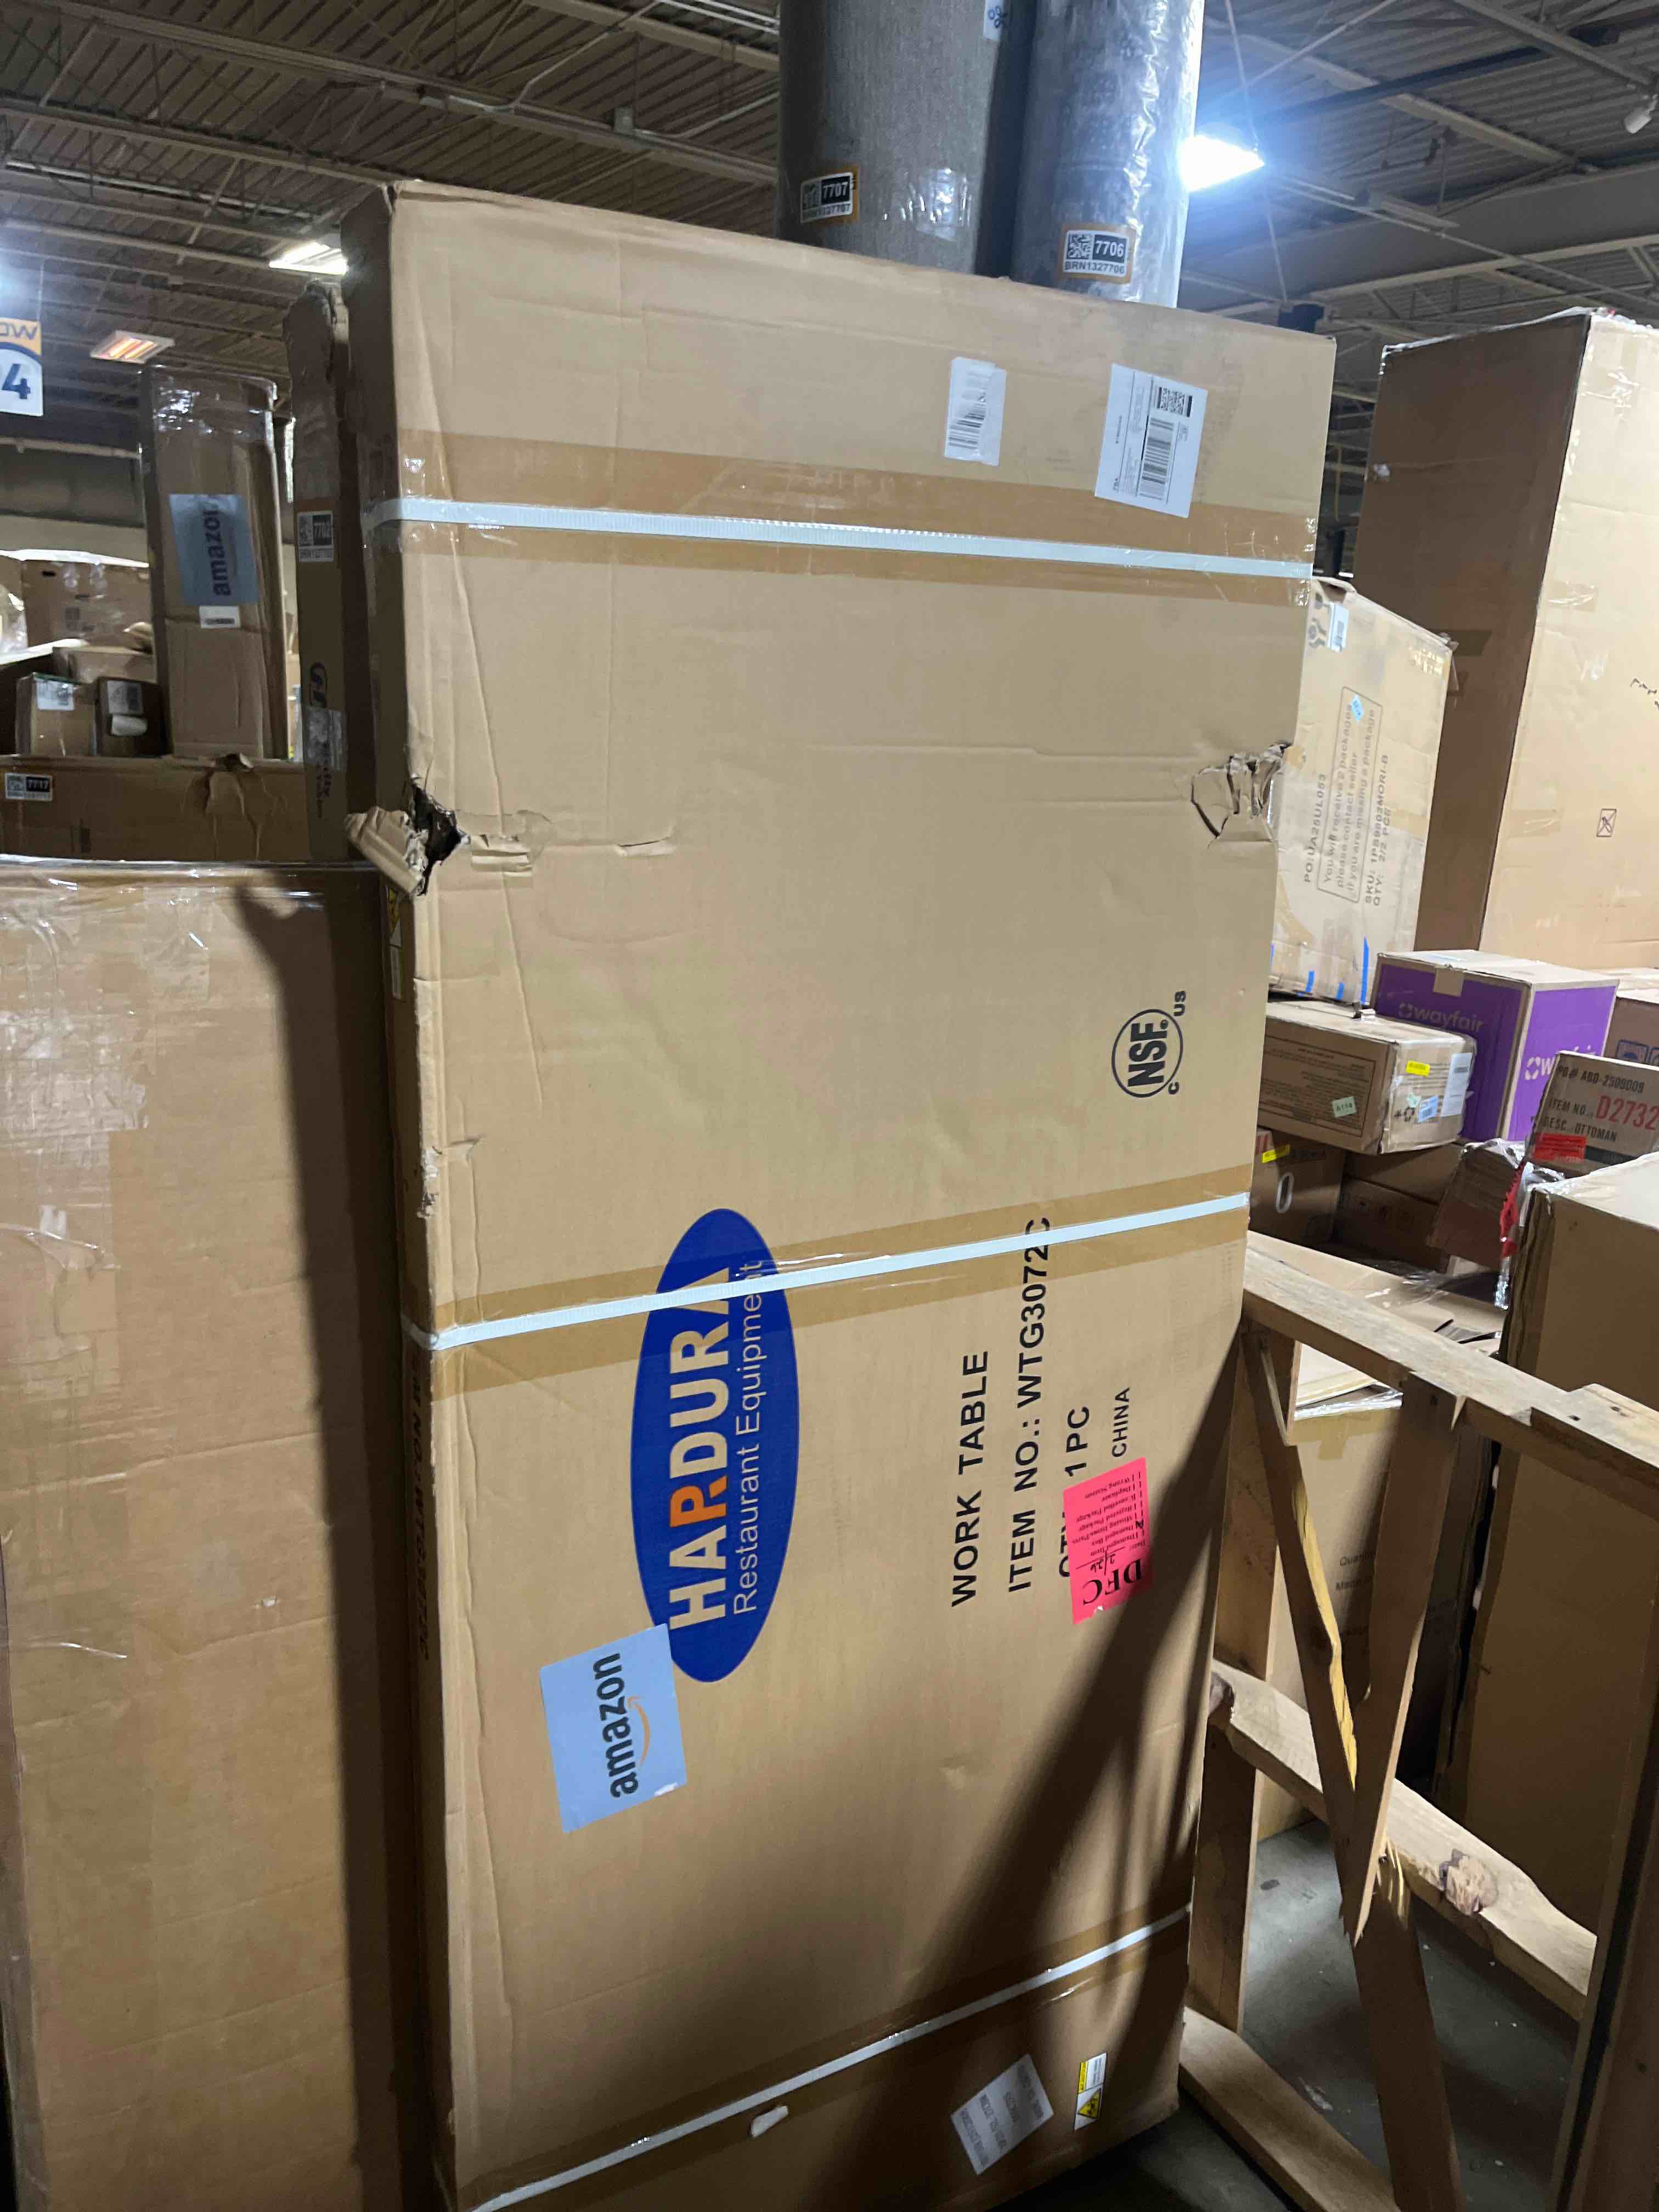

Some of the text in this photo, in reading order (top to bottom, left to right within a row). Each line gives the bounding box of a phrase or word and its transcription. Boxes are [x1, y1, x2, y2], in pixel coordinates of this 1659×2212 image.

[822, 182, 849, 199] 7707
[1065, 261, 1125, 274] BRN1327706
[1094, 240, 1125, 258] 7706
[1414, 1007, 1484, 1032] wayfair
[1127, 1023, 1167, 1087] NSF
[1575, 1122, 1618, 1142] OTTOMAN
[1013, 1420, 1040, 1492] NO.:
[1064, 1406, 1090, 1477] 1 PC
[1111, 1387, 1131, 1458] CHINA
[951, 1350, 988, 1607] WORK TABLE
[733, 1444, 759, 1616] Restaurant
[1007, 1509, 1036, 1594] ITEM
[1082, 1558, 1142, 1605] DFC
[592, 1652, 640, 1798] amazon
